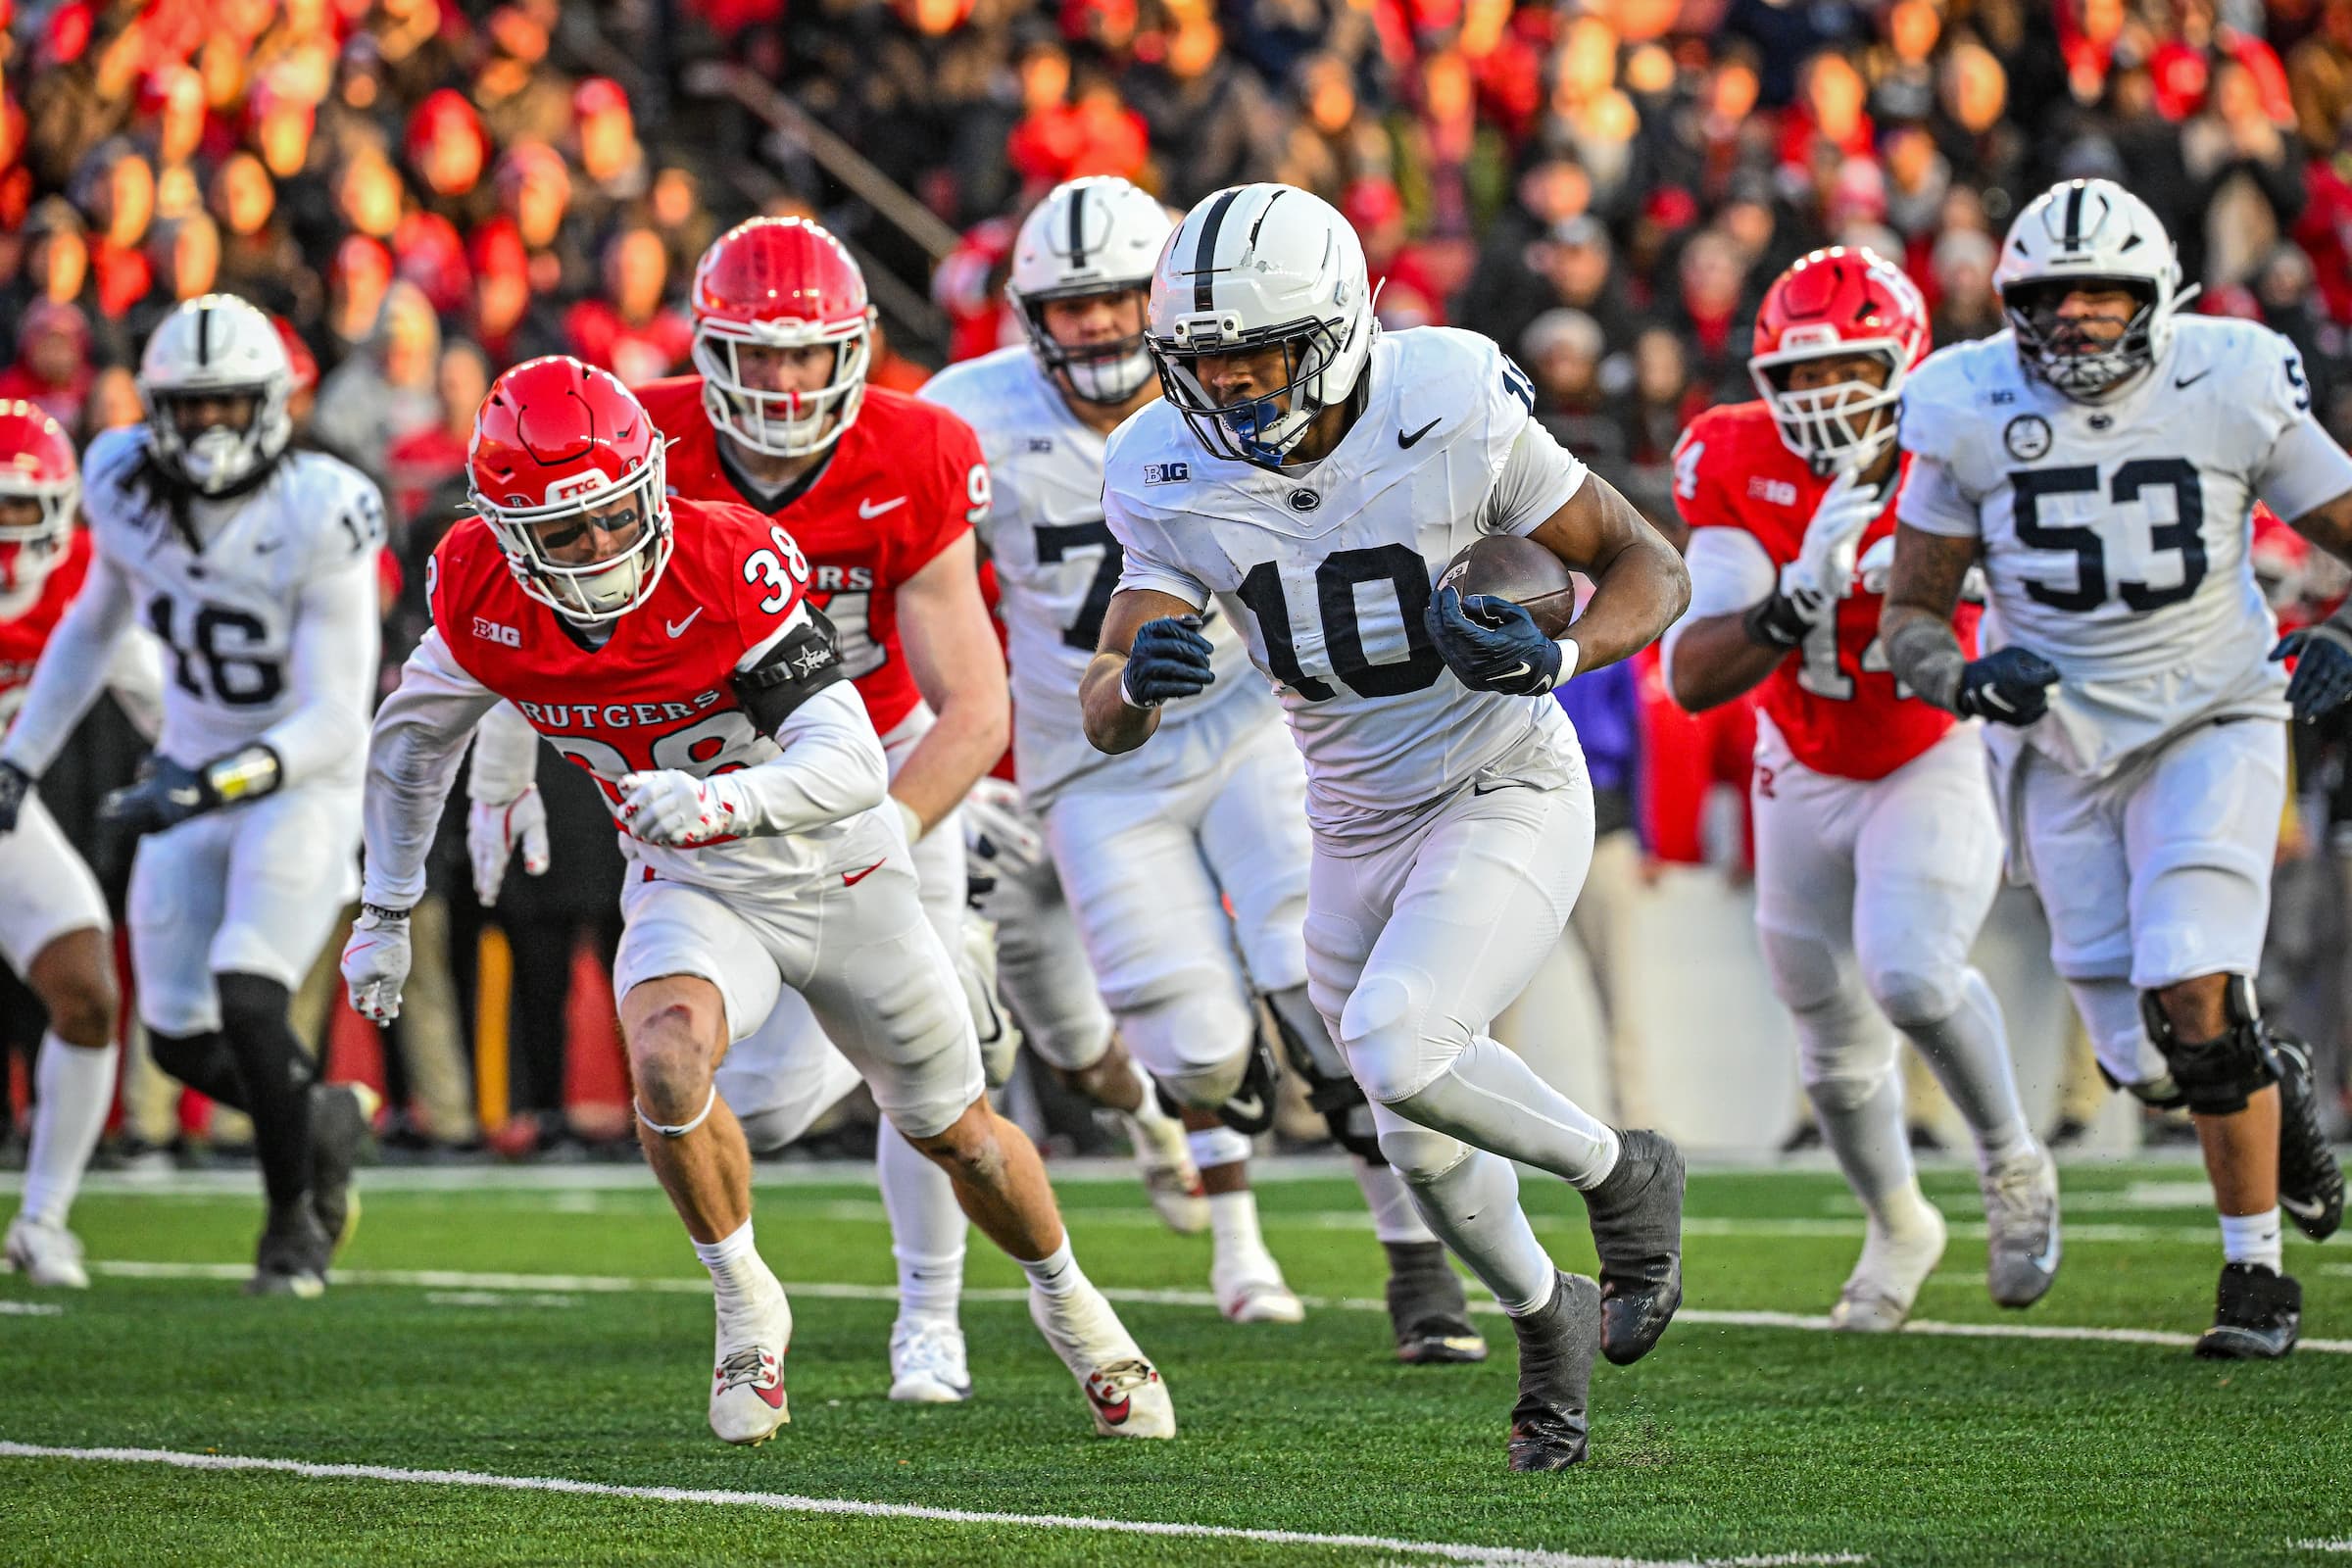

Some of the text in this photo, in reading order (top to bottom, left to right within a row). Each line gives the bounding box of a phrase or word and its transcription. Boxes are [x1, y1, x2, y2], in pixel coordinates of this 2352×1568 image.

[743, 525, 810, 615] 38
[2008, 457, 2209, 615] 53
[147, 593, 282, 707] 16
[1236, 542, 1449, 703] 10
[516, 689, 722, 730] RUTGERS
